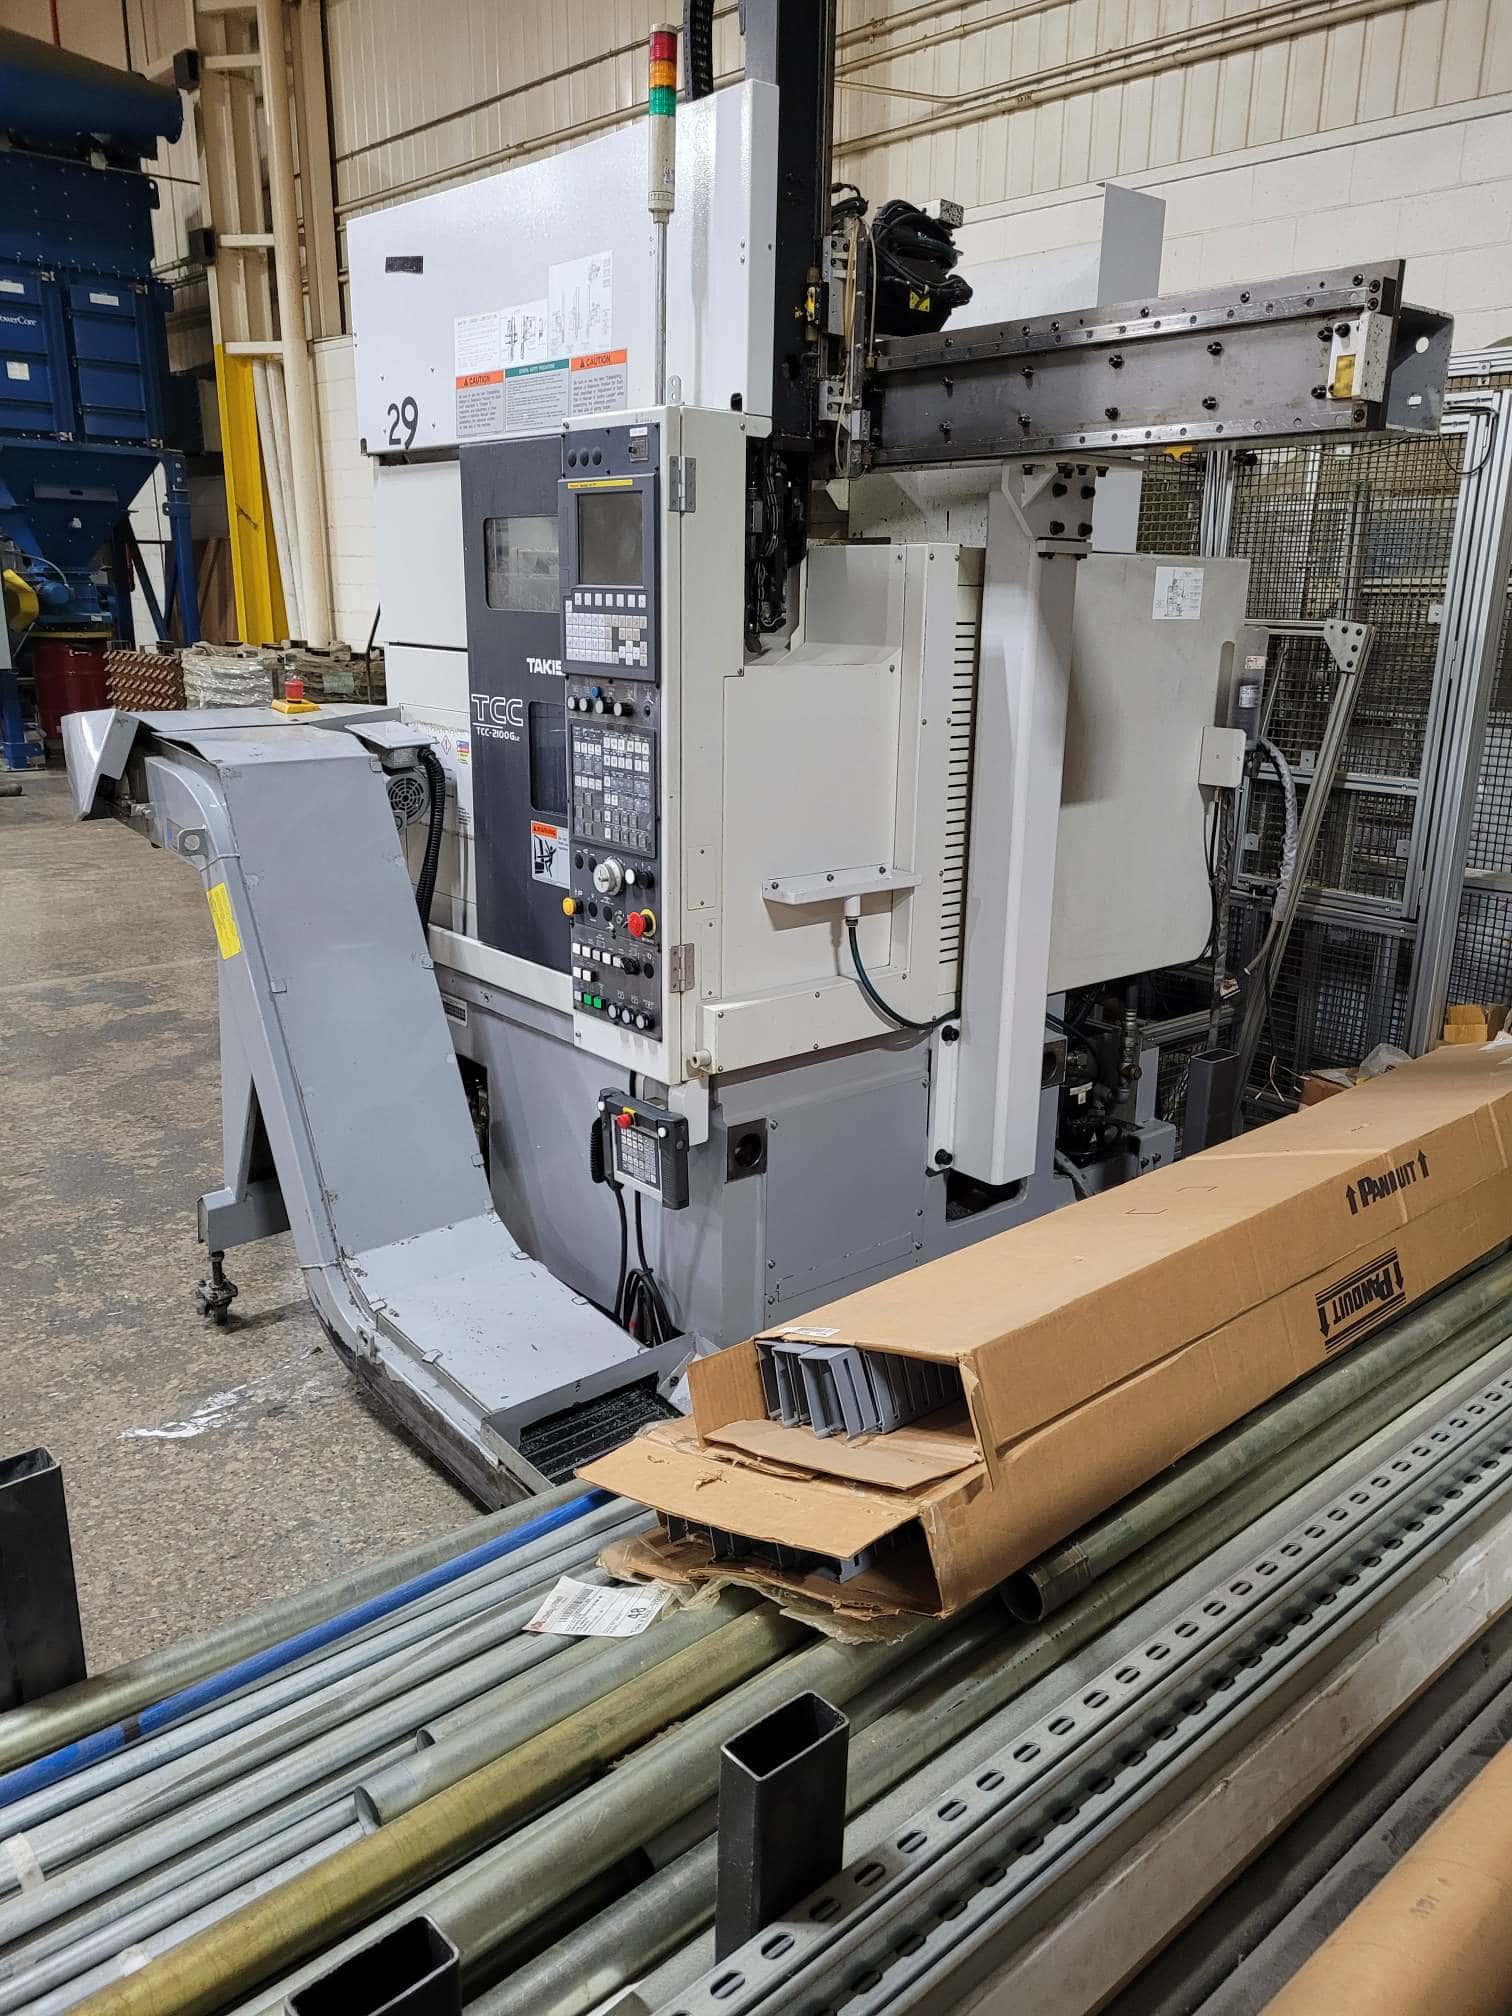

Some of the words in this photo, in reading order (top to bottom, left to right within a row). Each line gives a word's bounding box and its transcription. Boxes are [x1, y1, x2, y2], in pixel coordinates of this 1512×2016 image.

[0, 315, 38, 327] owerCore
[586, 354, 610, 367] CAUTION
[469, 375, 490, 387] CAUTION
[387, 396, 418, 449] 29
[471, 694, 523, 727] TCC
[1357, 1160, 1417, 1207] PANDUIT
[1333, 1268, 1394, 1325] PANDUIT
